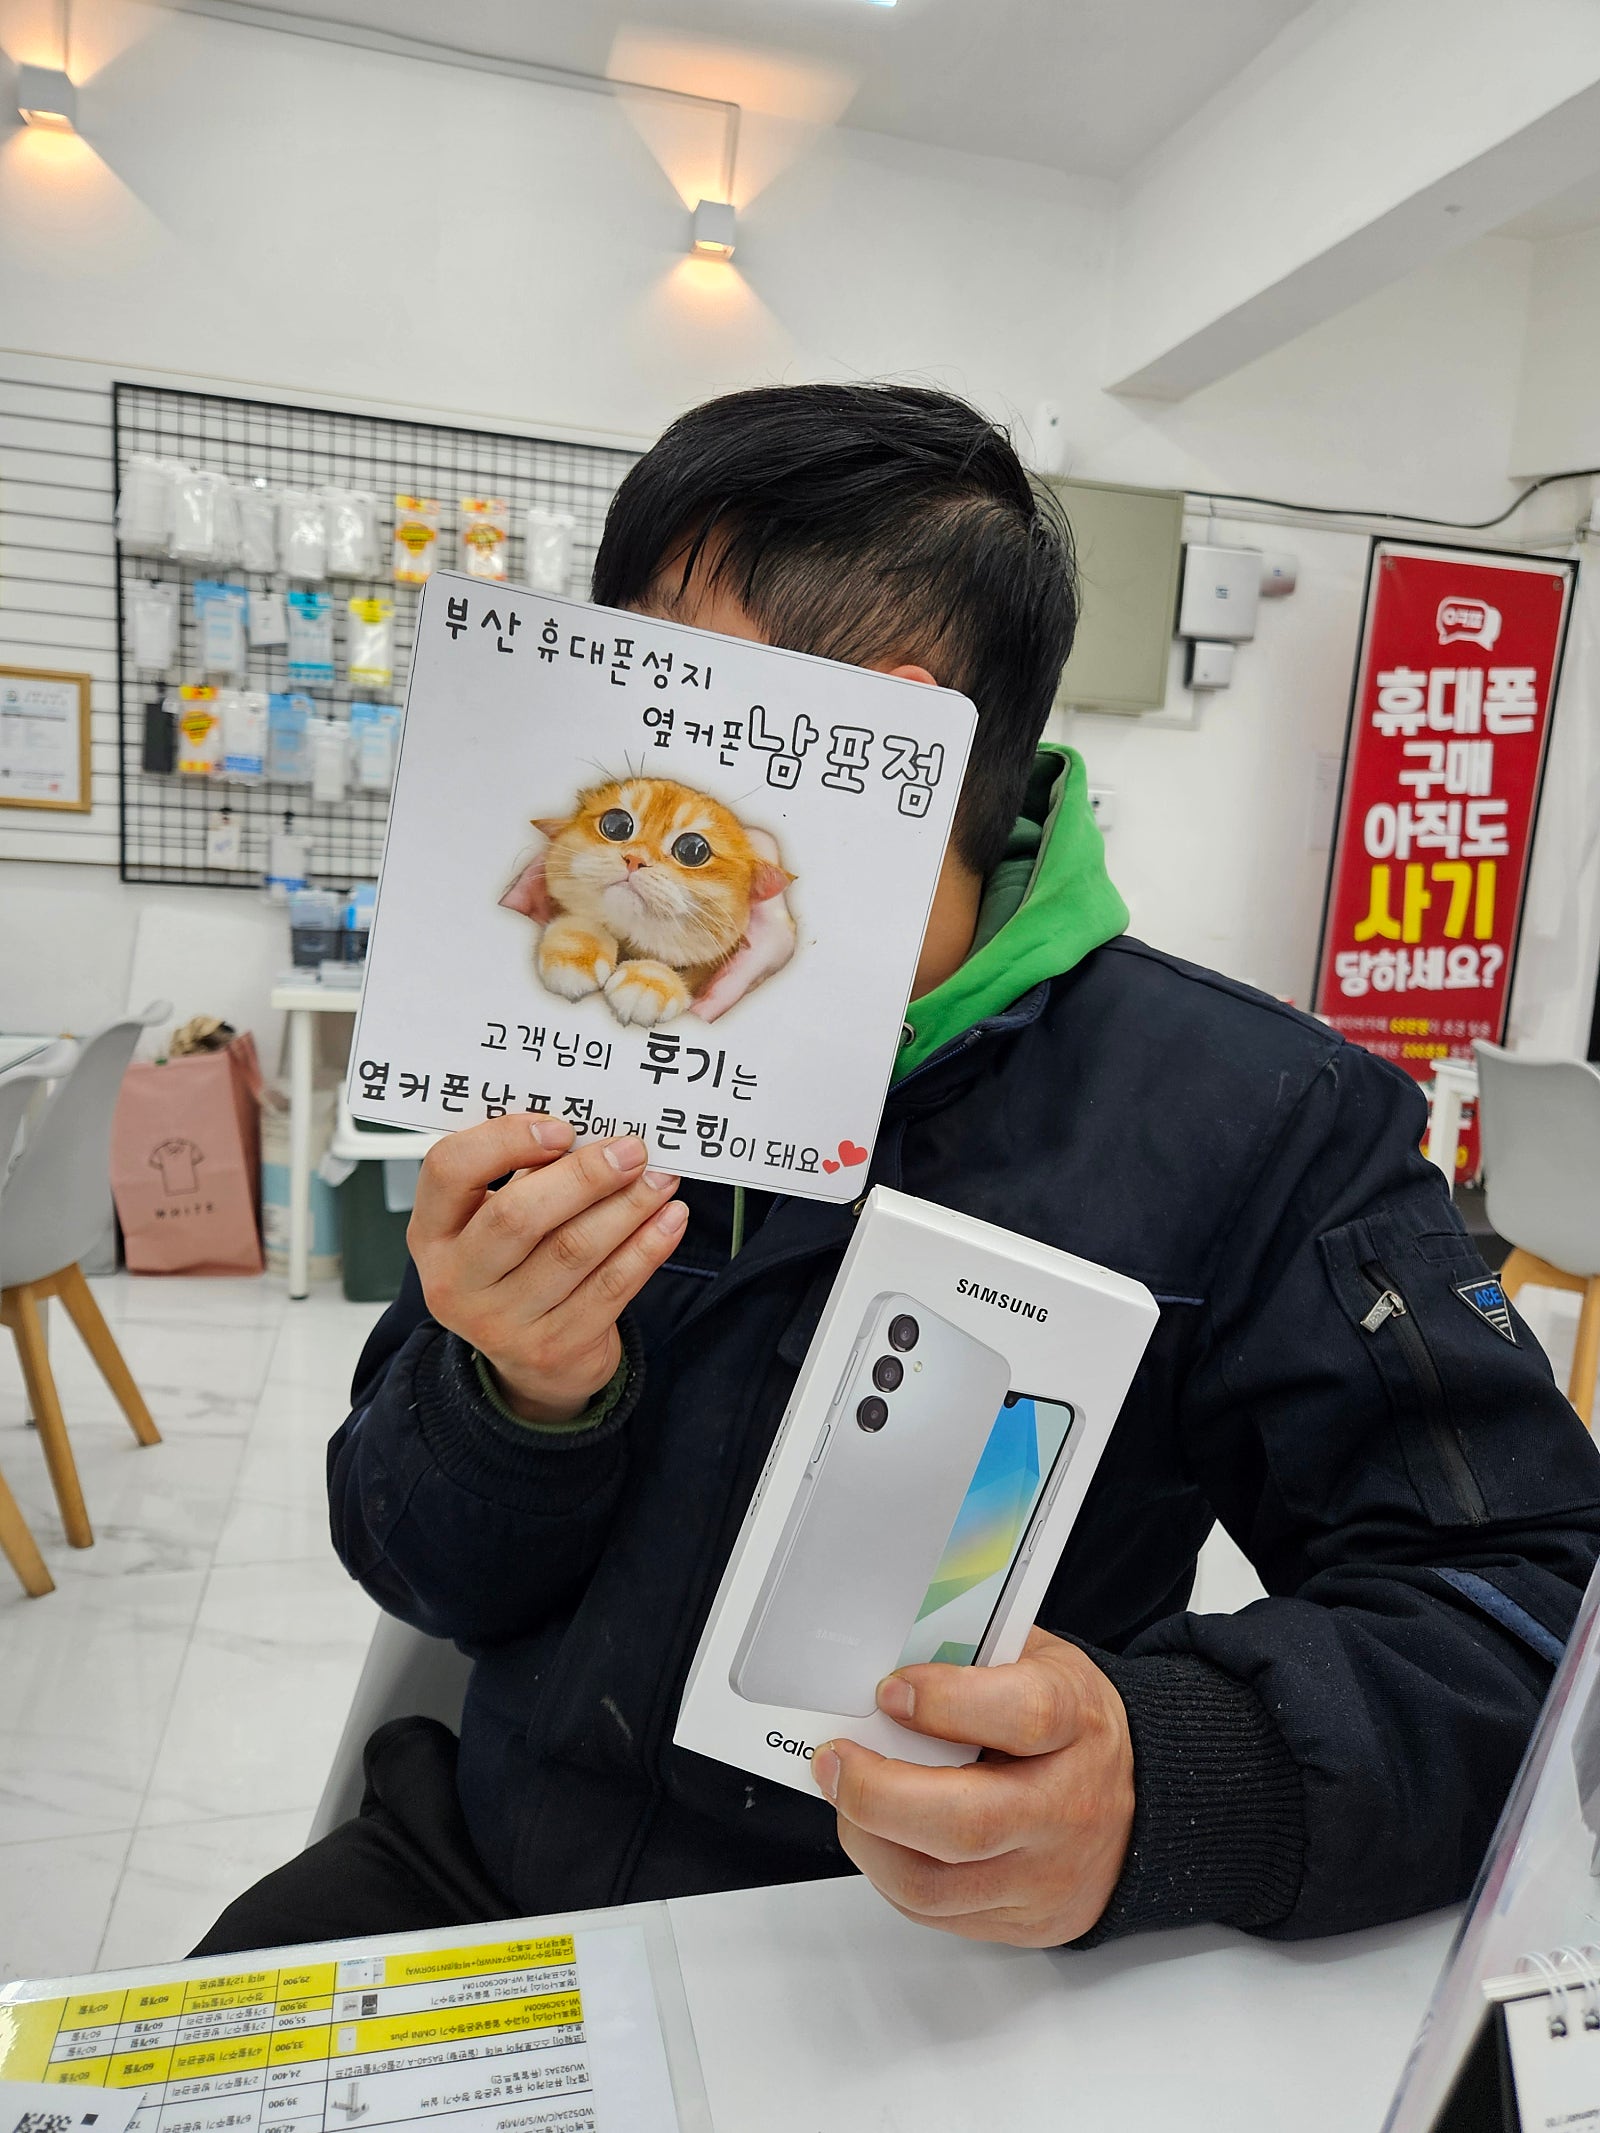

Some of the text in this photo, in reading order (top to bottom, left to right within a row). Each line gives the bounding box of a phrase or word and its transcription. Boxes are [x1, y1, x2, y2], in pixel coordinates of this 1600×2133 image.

[446, 597, 712, 690] 부산 휴대폰성지
[1371, 666, 1538, 736] 휴대폰
[1398, 739, 1494, 799] 구매
[1364, 799, 1509, 859] 아직도
[1354, 860, 1496, 944] 사기
[1335, 944, 1504, 997] 당하세요?
[481, 1022, 758, 1101] 고객님의 후기는
[764, 1141, 819, 1173] 돼요
[956, 1278, 1049, 1323] SAMSUNG
[1474, 1287, 1503, 1307] ACE
[284, 1976, 310, 1985] 29,900
[140, 1996, 168, 2006] 60개월
[238, 1993, 263, 2003] 정수기
[79, 2004, 108, 2015] 60개월
[280, 2002, 308, 2011] 39,900
[279, 2016, 306, 2026] 55,900
[135, 2022, 163, 2032] 60개월
[184, 2022, 265, 2040] 2개월주기 방문관리
[72, 2030, 101, 2041] 60개월
[391, 2030, 408, 2041] plus
[412, 2029, 436, 2038] OMNI
[131, 2037, 159, 2048] 36개월
[276, 2041, 304, 2051] 33,900
[67, 2045, 97, 2057] 60개월
[123, 2063, 154, 2075] 60개월
[545, 2064, 584, 2074] WU923AS
[272, 2070, 301, 2080] 24,400
[173, 2076, 258, 2096] 2개월주기 방문관리
[269, 2097, 298, 2108] 39,900
[421, 2097, 438, 2108] 실버
[443, 2093, 470, 2104] 정수기
[207, 2115, 251, 2129] 6개월주기
